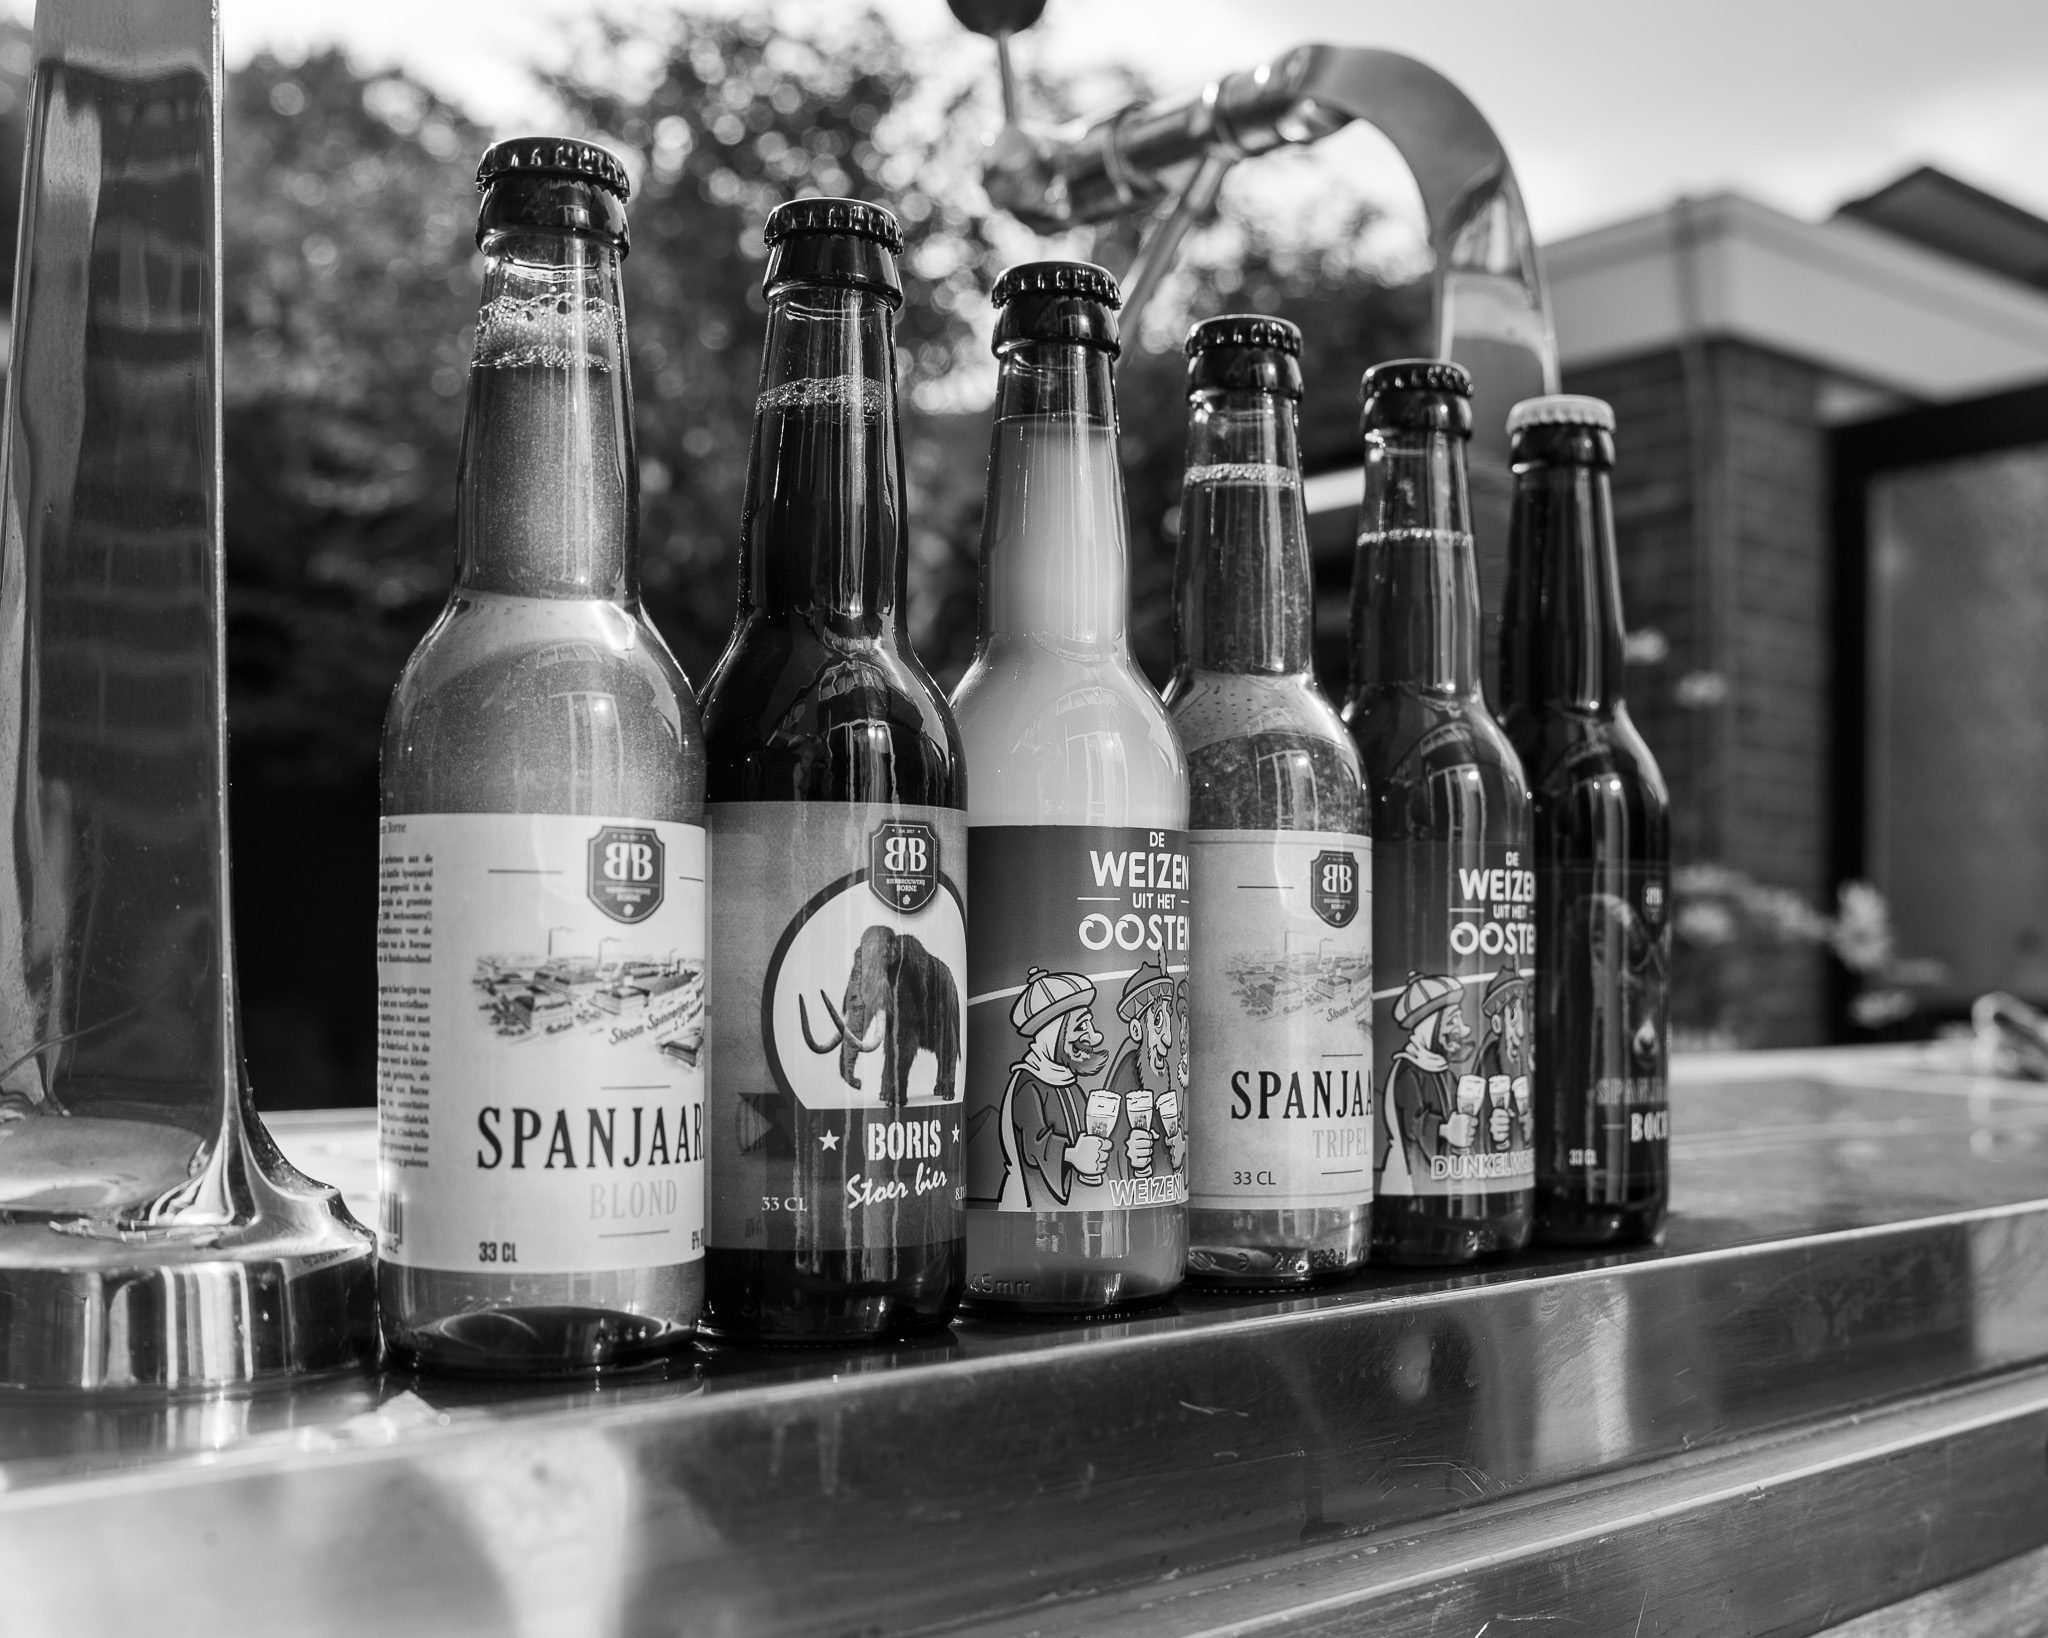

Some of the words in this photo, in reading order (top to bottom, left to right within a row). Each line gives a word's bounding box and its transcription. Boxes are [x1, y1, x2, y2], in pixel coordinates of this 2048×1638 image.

[1149, 831, 1165, 848] DE
[1089, 850, 1189, 891] WEIZEN
[1505, 851, 1520, 867] DE
[1132, 892, 1154, 909] UIT
[1157, 893, 1176, 910] HET
[1493, 903, 1511, 919] UIT
[1078, 912, 1190, 952] OOSTEN
[1449, 921, 1536, 956] OOSTE
[1231, 1070, 1373, 1120] SPANJAA
[477, 1103, 705, 1169] SPANJAAR
[867, 1119, 942, 1161] BORIS
[1312, 1127, 1370, 1158] TRIPEL
[846, 1173, 909, 1209] Stoer
[914, 1161, 948, 1196] bier
[1109, 1173, 1183, 1207] WEIZEN
[1233, 1171, 1252, 1186] 33
[1256, 1171, 1276, 1186] CL
[589, 1179, 678, 1221] BLOND
[761, 1196, 780, 1211] 33
[784, 1196, 808, 1212] CL
[478, 1241, 497, 1263] 33
